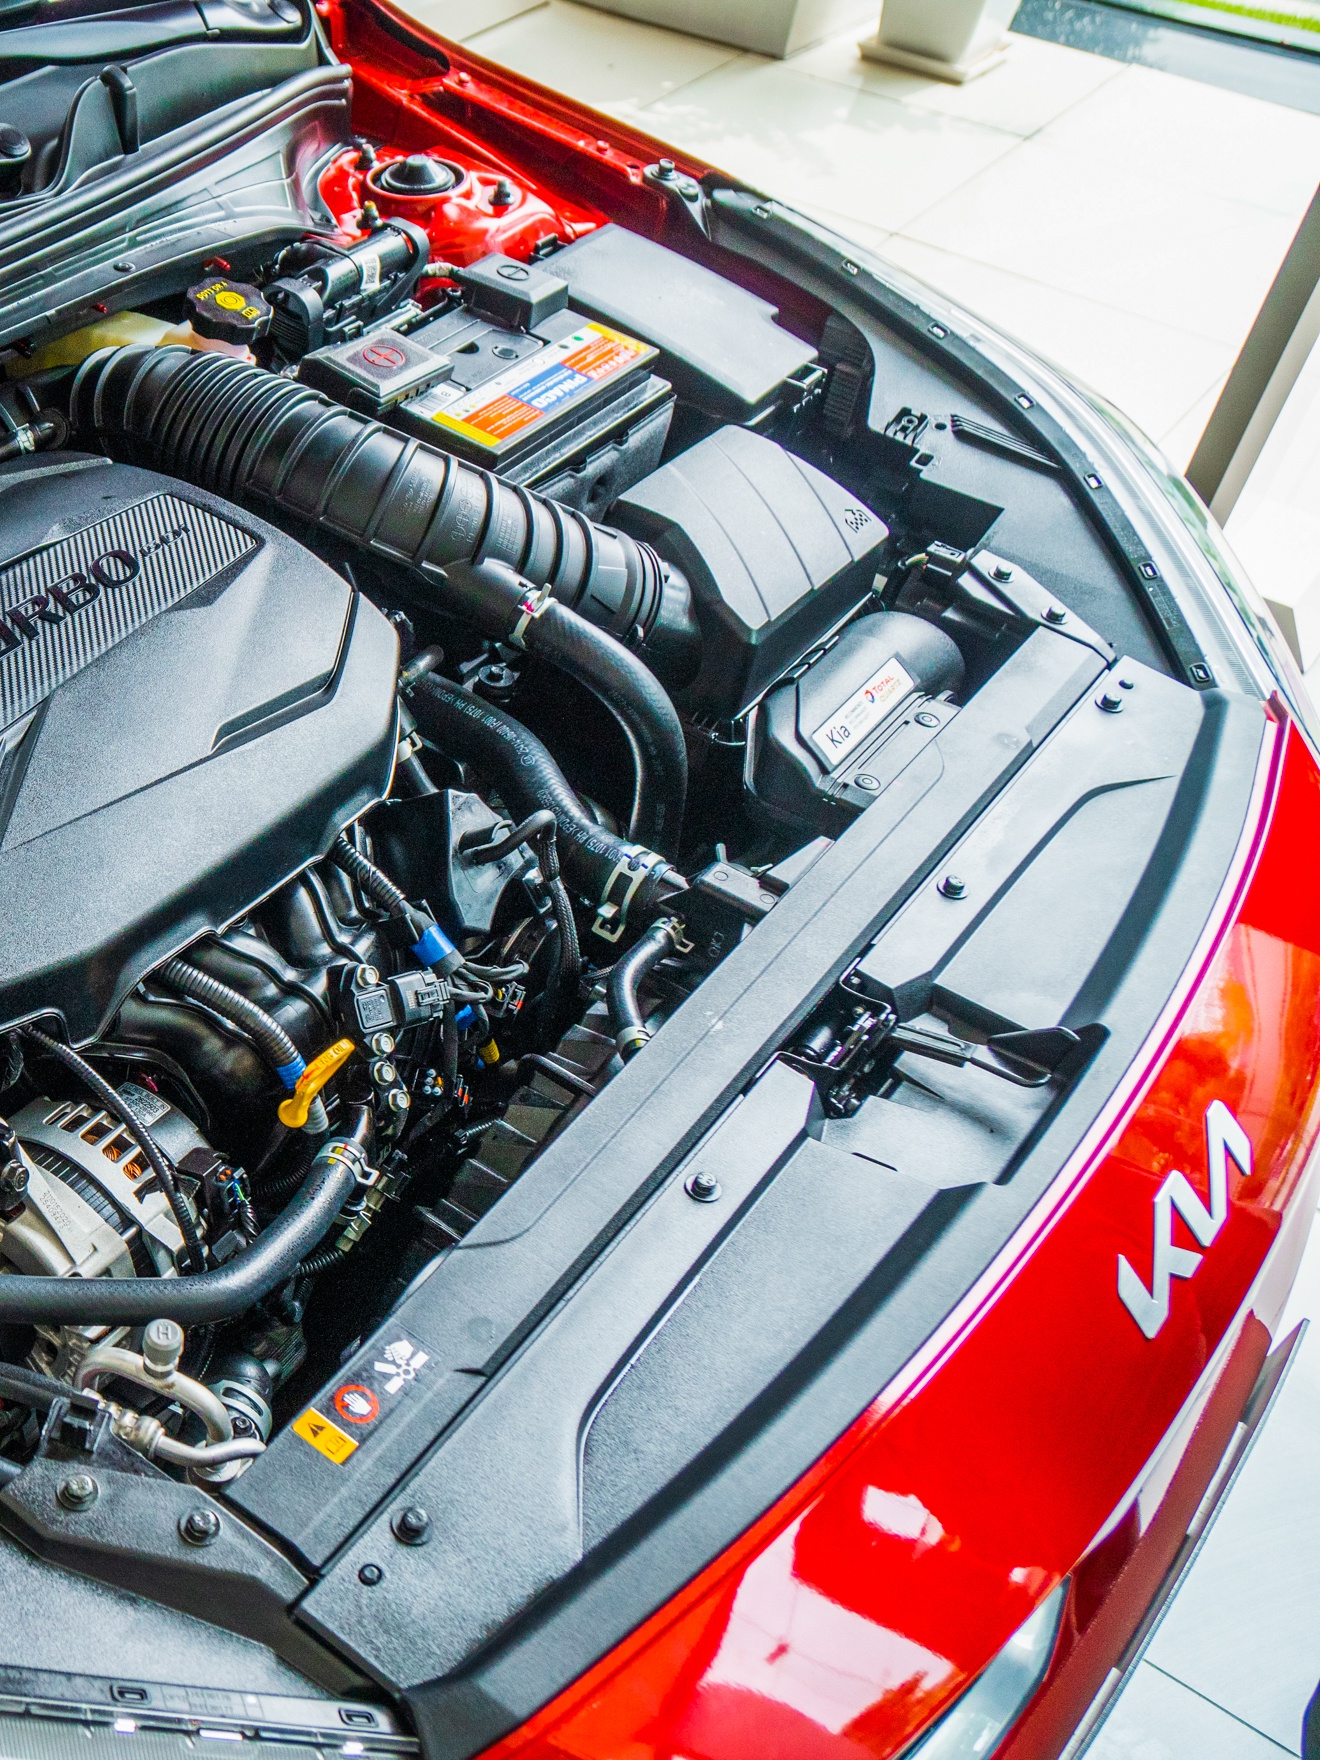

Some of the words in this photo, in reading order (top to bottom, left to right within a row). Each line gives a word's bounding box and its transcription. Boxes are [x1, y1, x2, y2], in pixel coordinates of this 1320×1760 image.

[530, 372, 589, 409] PINACO
[873, 674, 895, 695] TOTAL
[879, 678, 902, 703] QUARTZ
[825, 722, 852, 749] Kia
[574, 828, 590, 845] PH
[584, 836, 608, 854] 1075)
[332, 1040, 351, 1057] OIL
[156, 1324, 172, 1341] H
